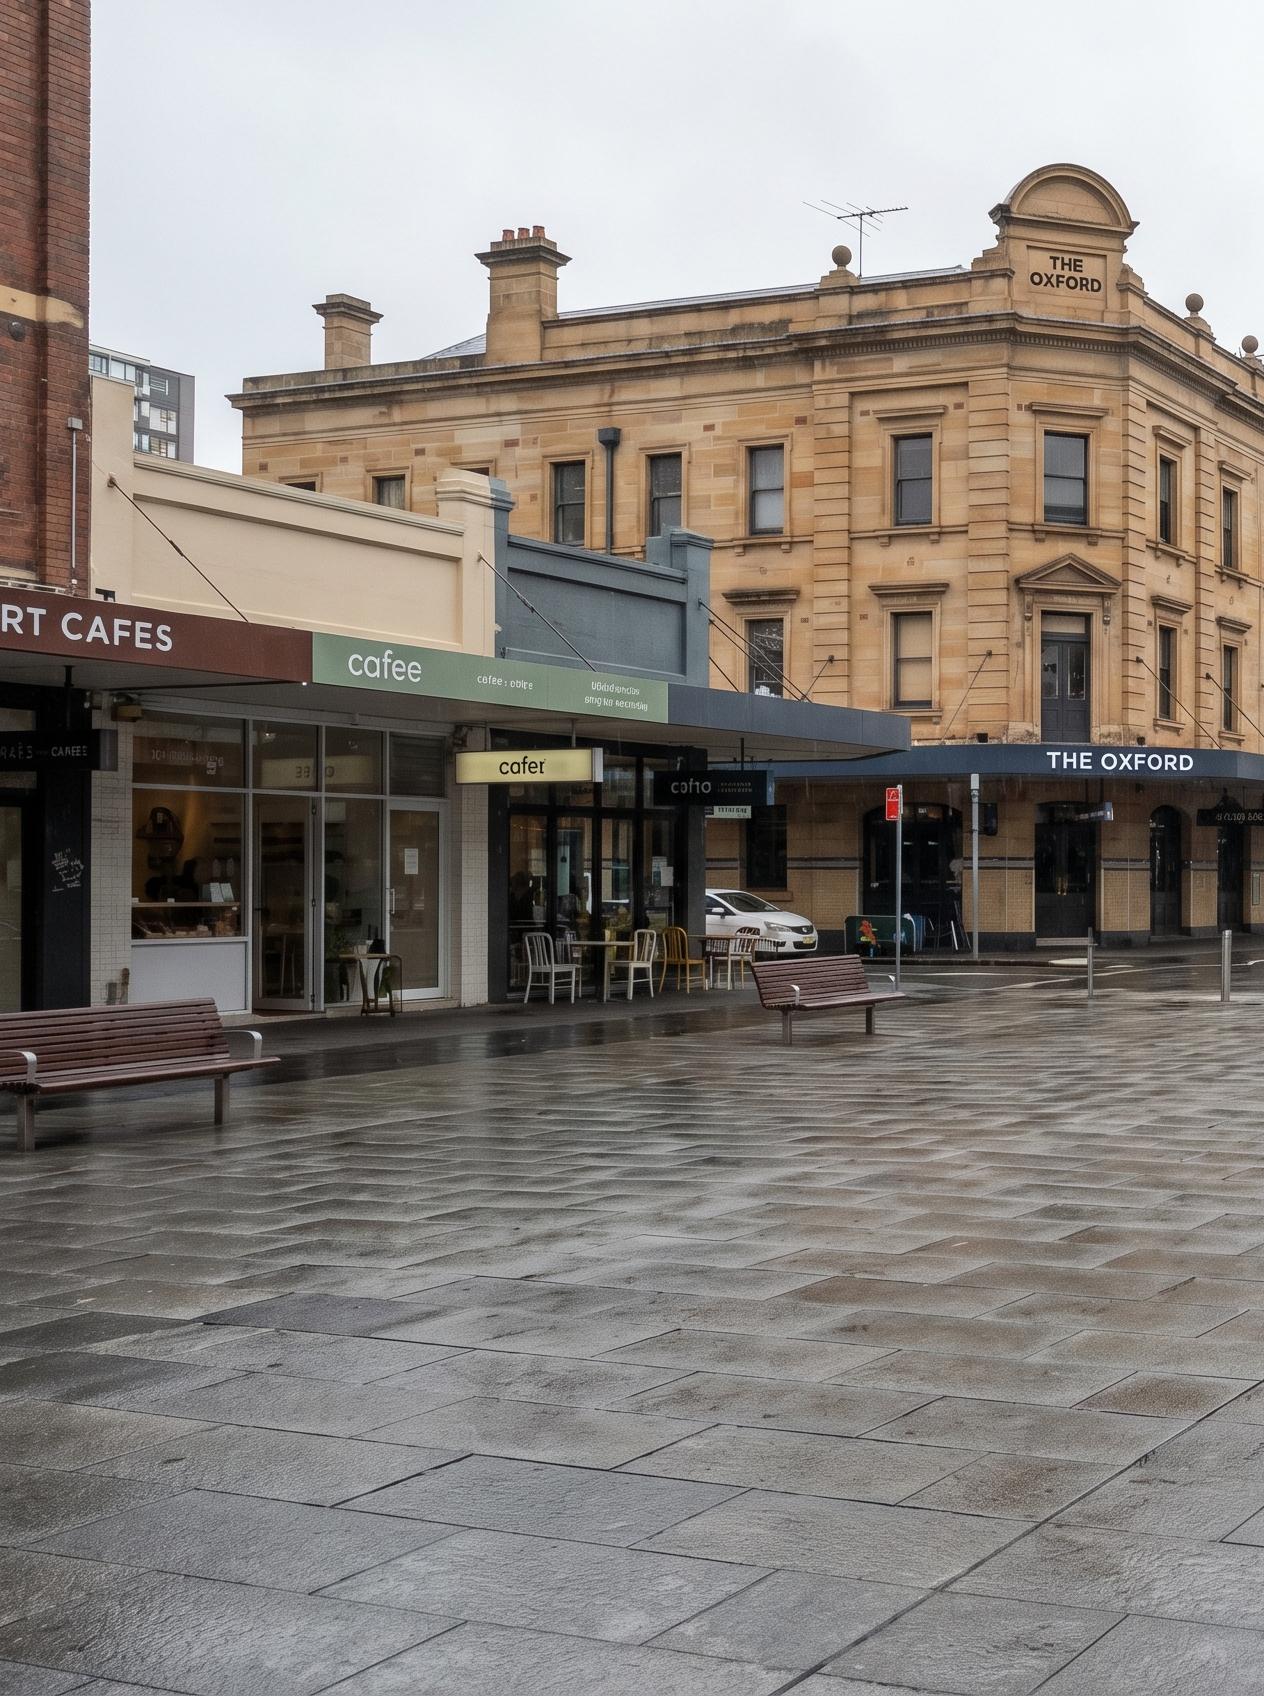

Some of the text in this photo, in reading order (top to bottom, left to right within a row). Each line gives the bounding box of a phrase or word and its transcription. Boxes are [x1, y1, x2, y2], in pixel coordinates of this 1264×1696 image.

[1049, 255, 1084, 273] THE
[1030, 271, 1102, 293] OXFORD
[61, 612, 173, 652] CAFES
[348, 649, 422, 683] cafee
[1046, 752, 1194, 771] THE OXFORD
